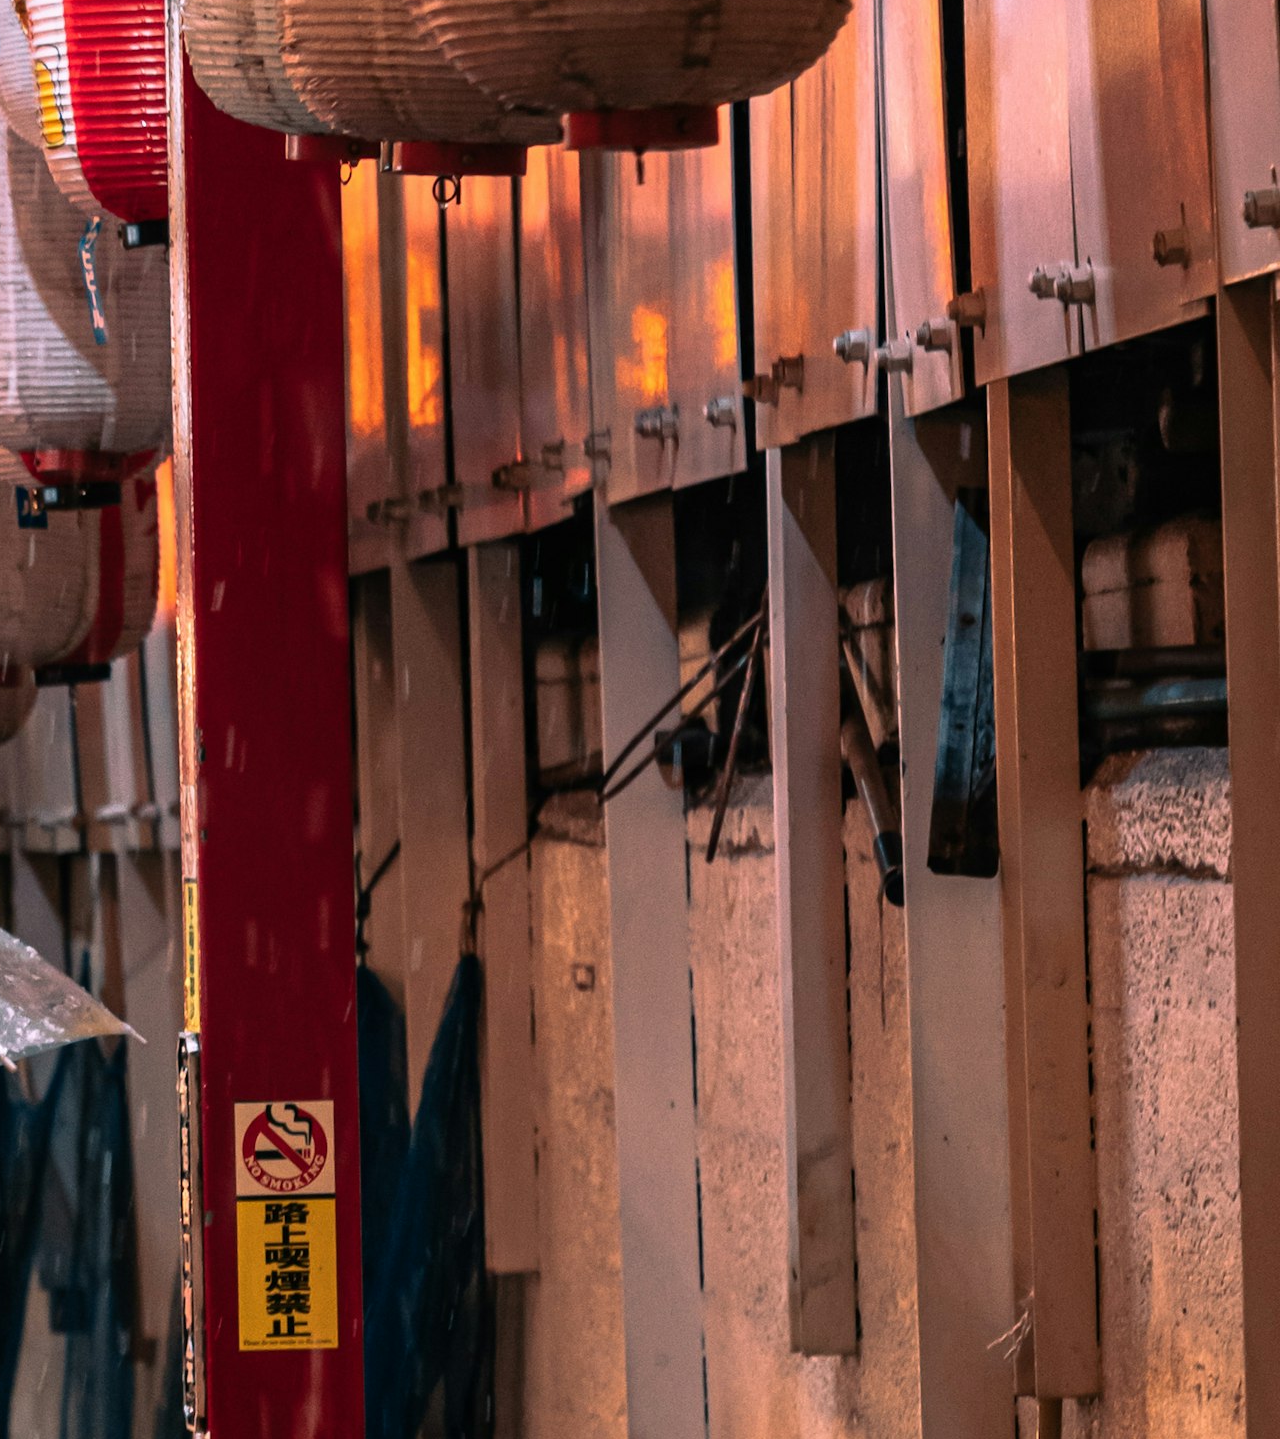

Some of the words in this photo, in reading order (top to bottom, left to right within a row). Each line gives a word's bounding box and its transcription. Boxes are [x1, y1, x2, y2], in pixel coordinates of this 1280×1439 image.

[244, 1155, 261, 1178] NO
[260, 1154, 325, 1192] SMOKING
[264, 1203, 312, 1339] 路上喫煙禁止
